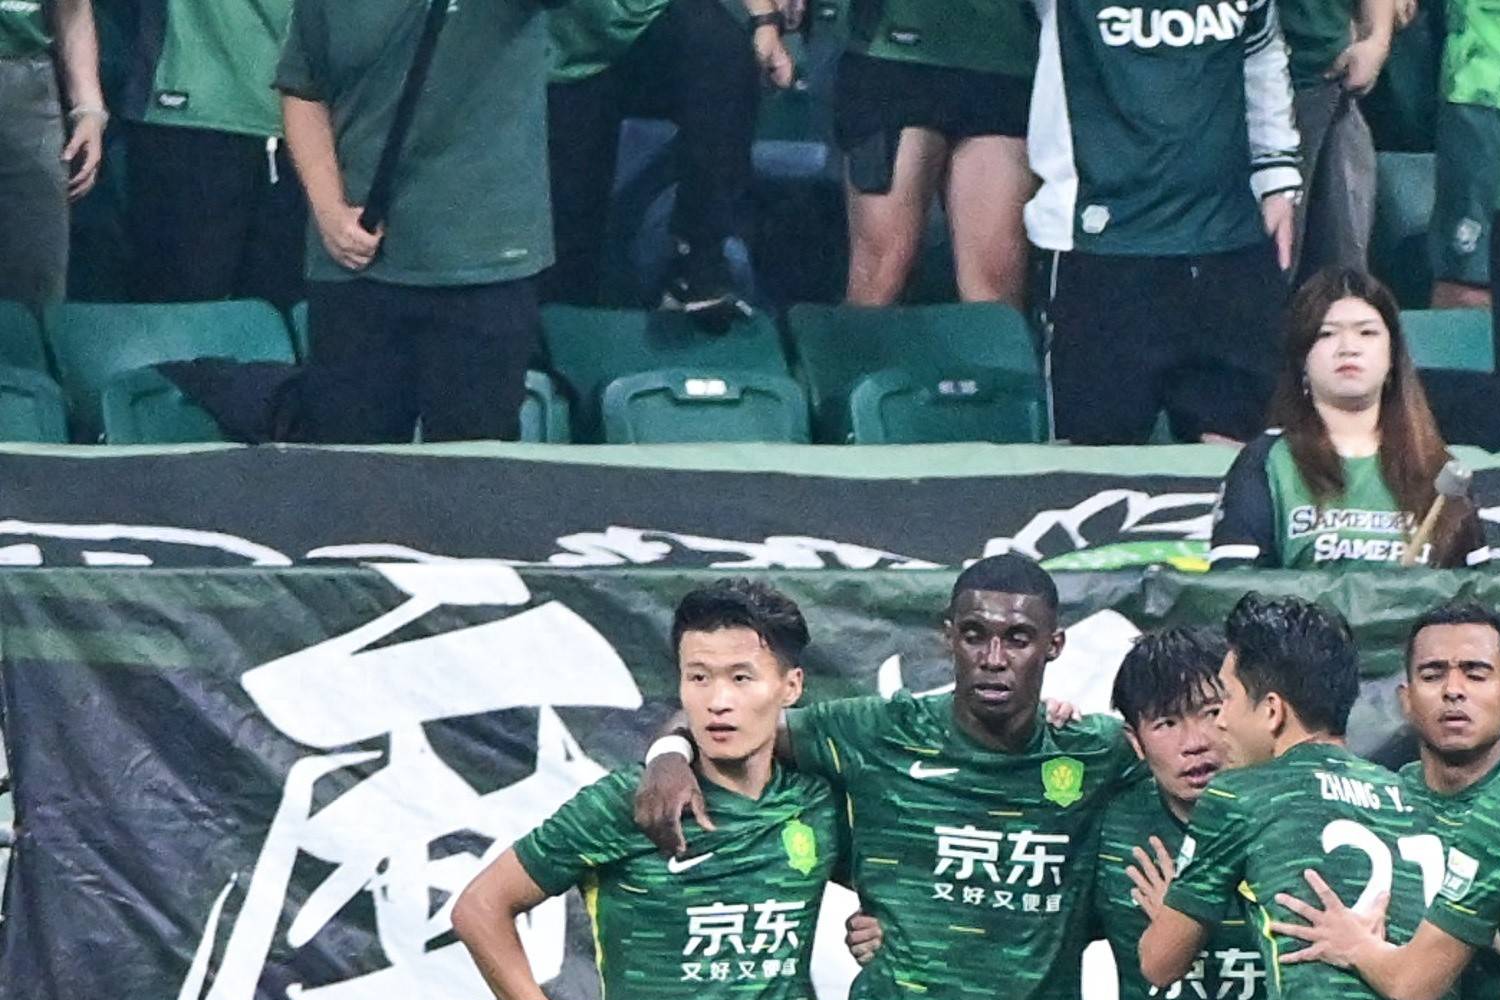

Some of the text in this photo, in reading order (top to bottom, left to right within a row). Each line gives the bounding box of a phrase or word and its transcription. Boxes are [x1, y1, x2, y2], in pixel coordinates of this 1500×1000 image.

[1096, 0, 1248, 48] GUOAN
[1314, 772, 1414, 813] ZHANG Y.
[933, 825, 1070, 887] 京东
[682, 899, 806, 956] 京东
